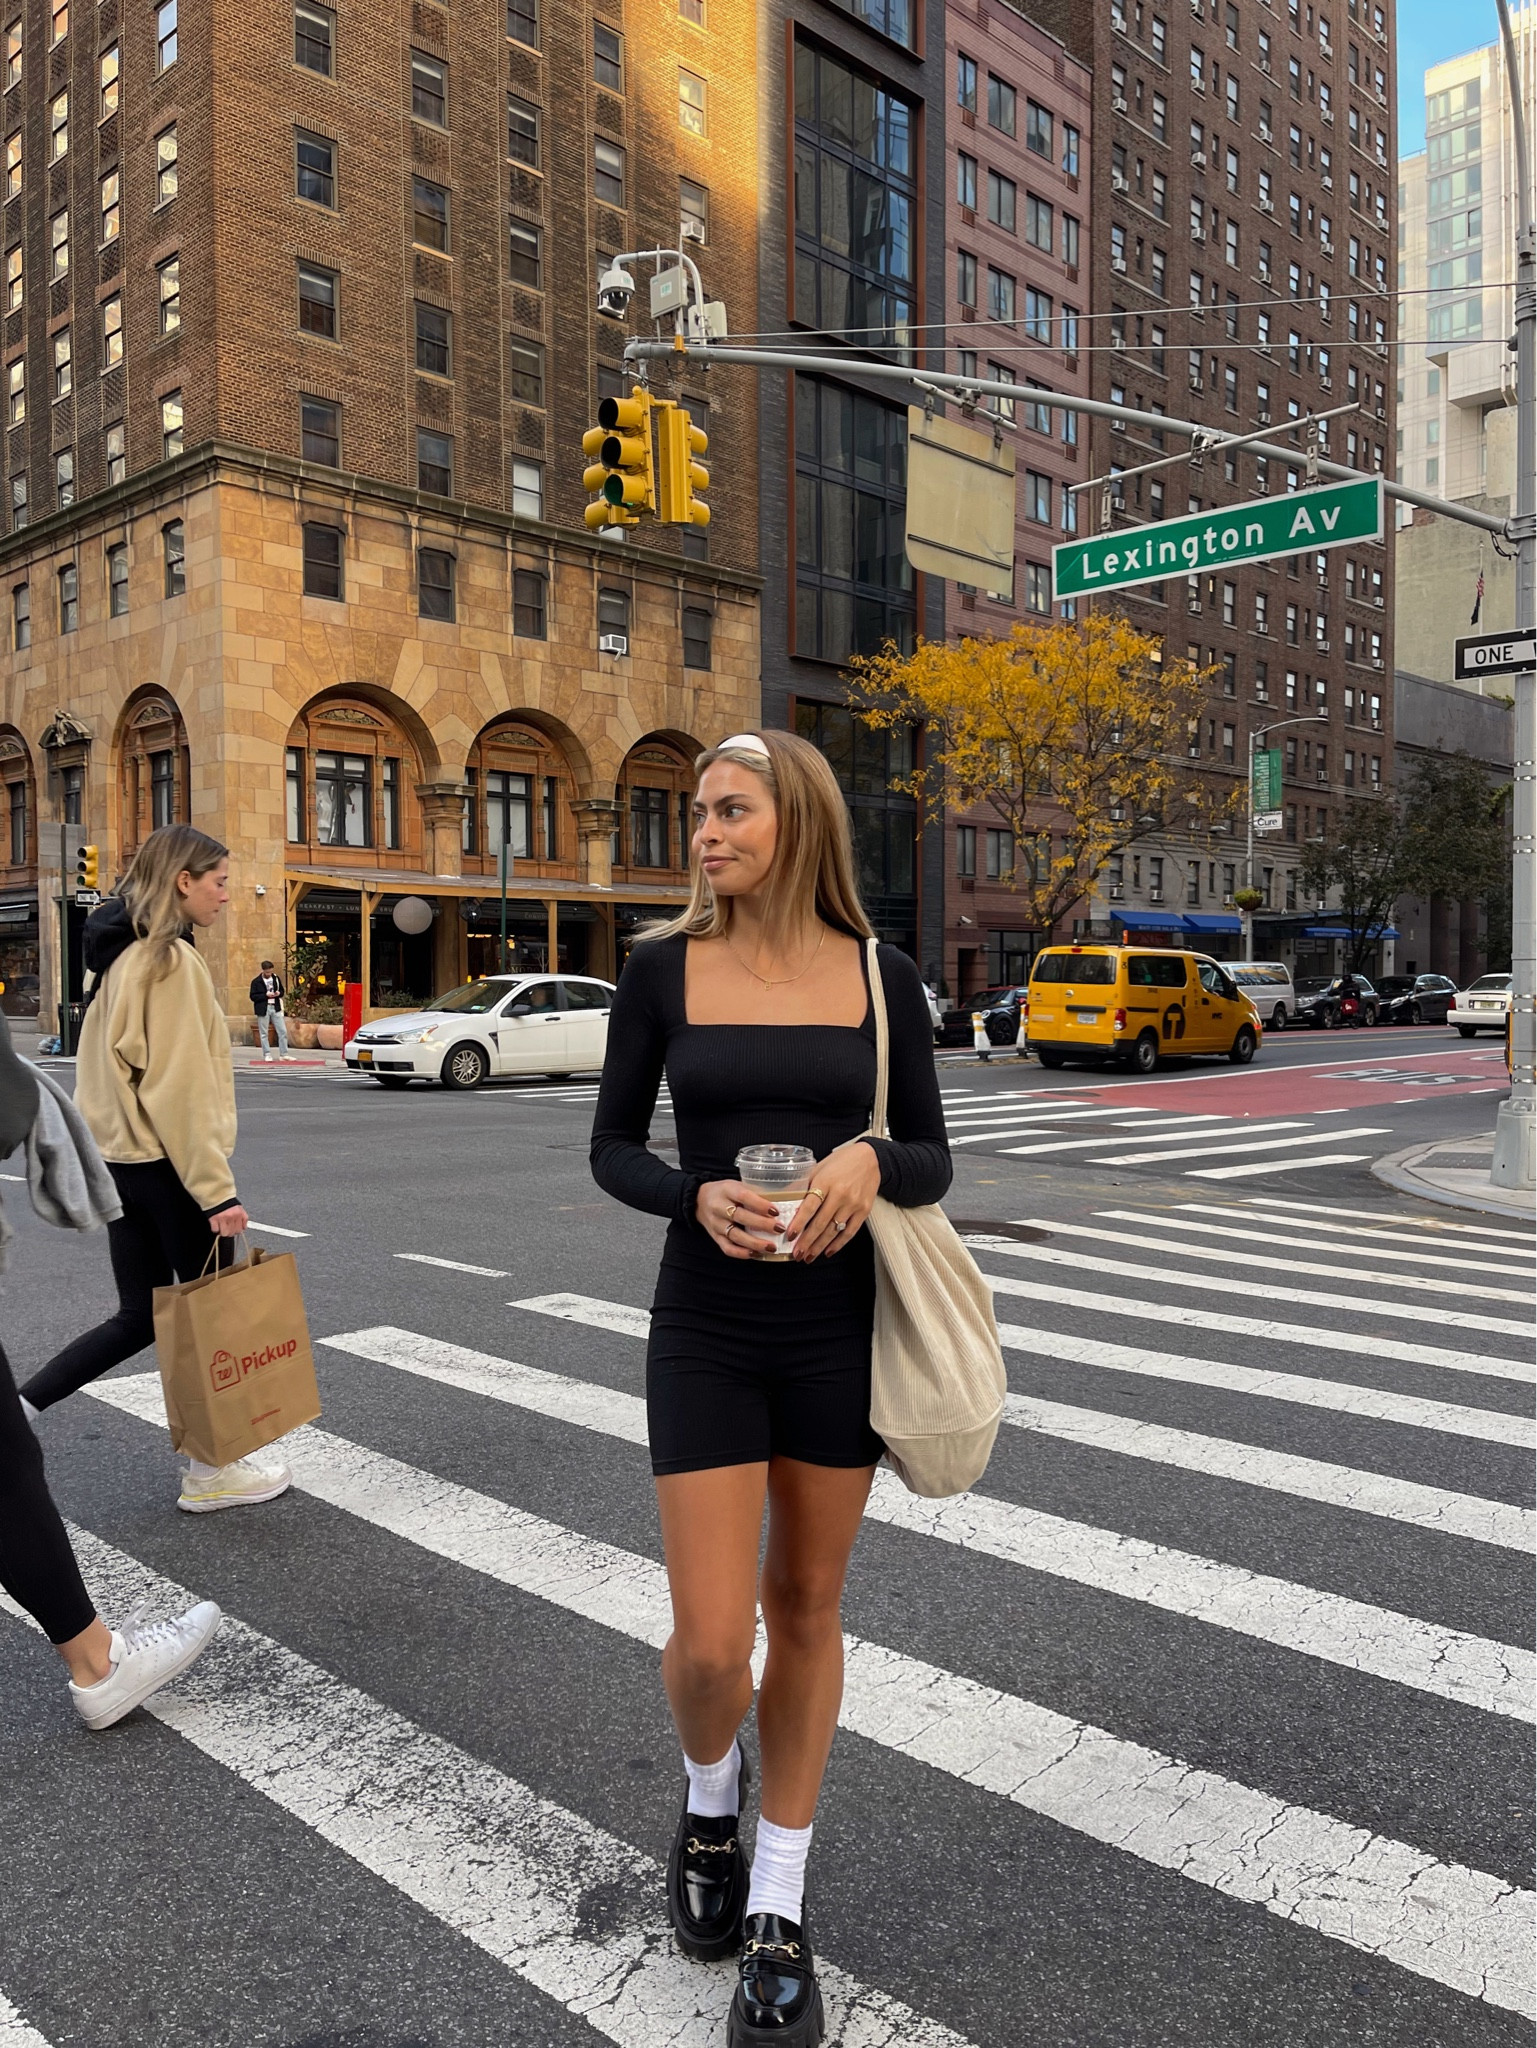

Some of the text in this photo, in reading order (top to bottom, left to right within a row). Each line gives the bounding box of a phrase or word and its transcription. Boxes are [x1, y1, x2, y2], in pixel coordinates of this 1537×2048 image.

[1082, 506, 1341, 580] Lexington Av
[1474, 645, 1514, 665] ONE
[240, 1339, 297, 1375] Pickup
